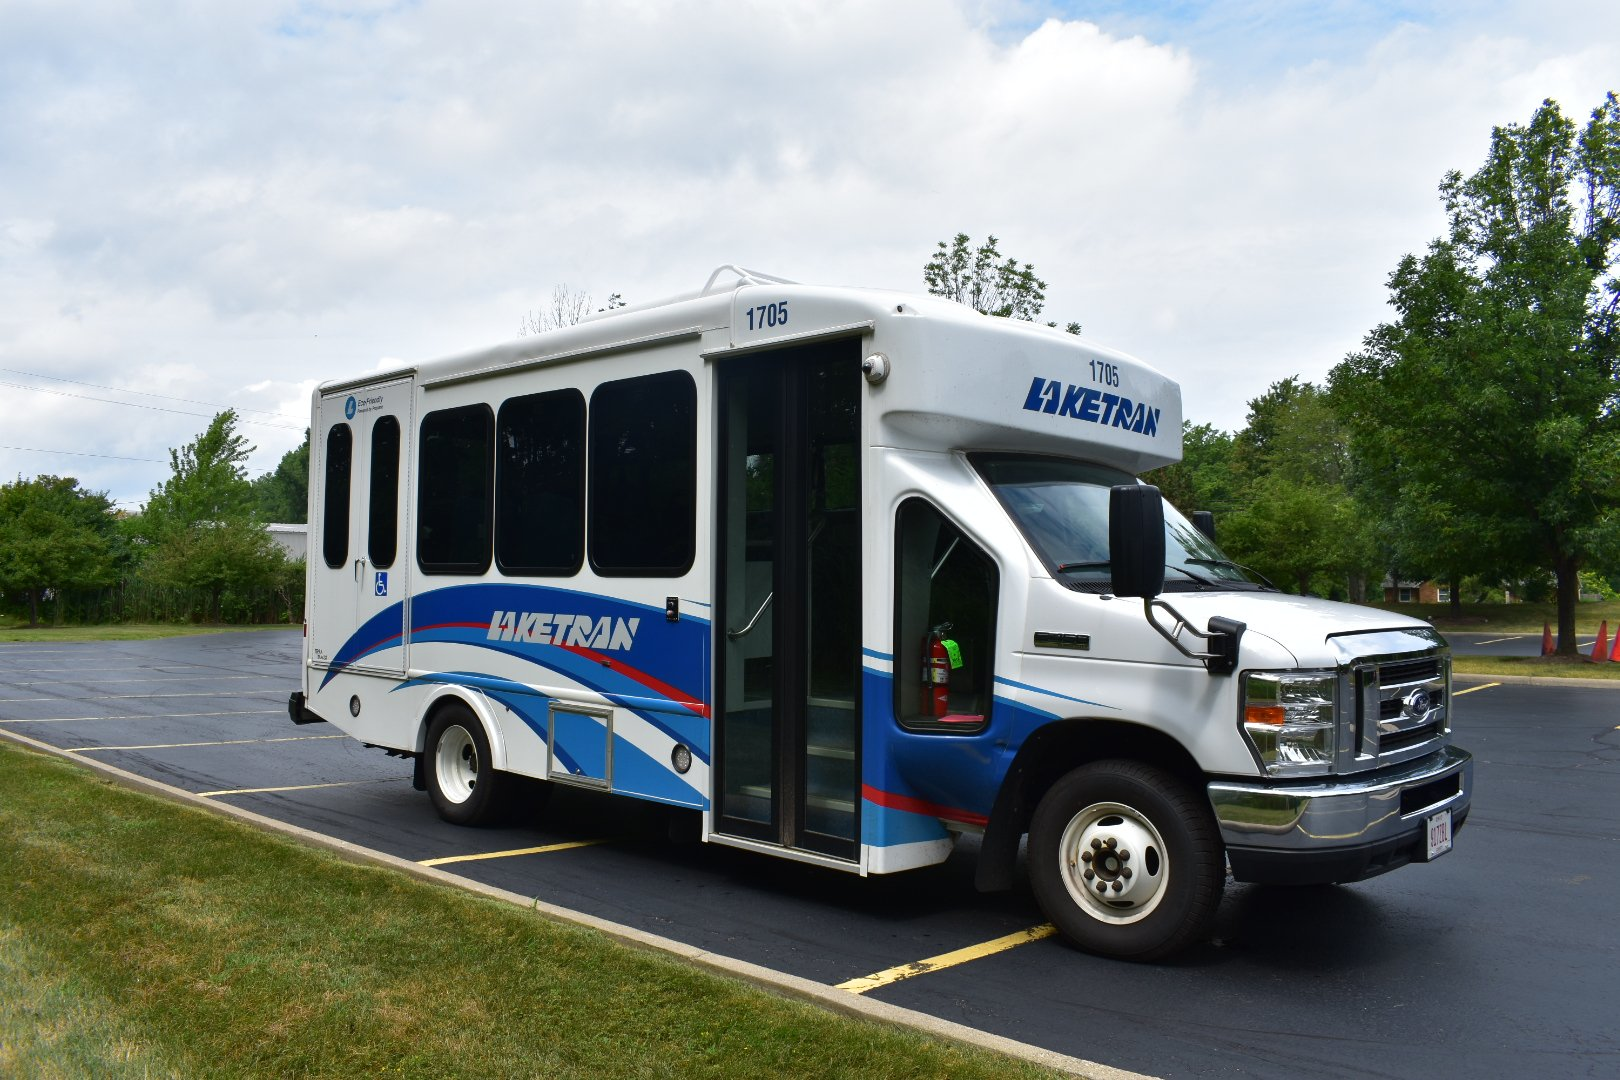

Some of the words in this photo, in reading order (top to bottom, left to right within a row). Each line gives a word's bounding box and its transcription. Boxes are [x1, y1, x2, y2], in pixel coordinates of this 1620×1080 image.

[746, 300, 788, 331] 1705
[1089, 359, 1120, 388] 1705
[1022, 376, 1161, 438] LAKETRAN
[486, 610, 641, 651] LAKETRAN
